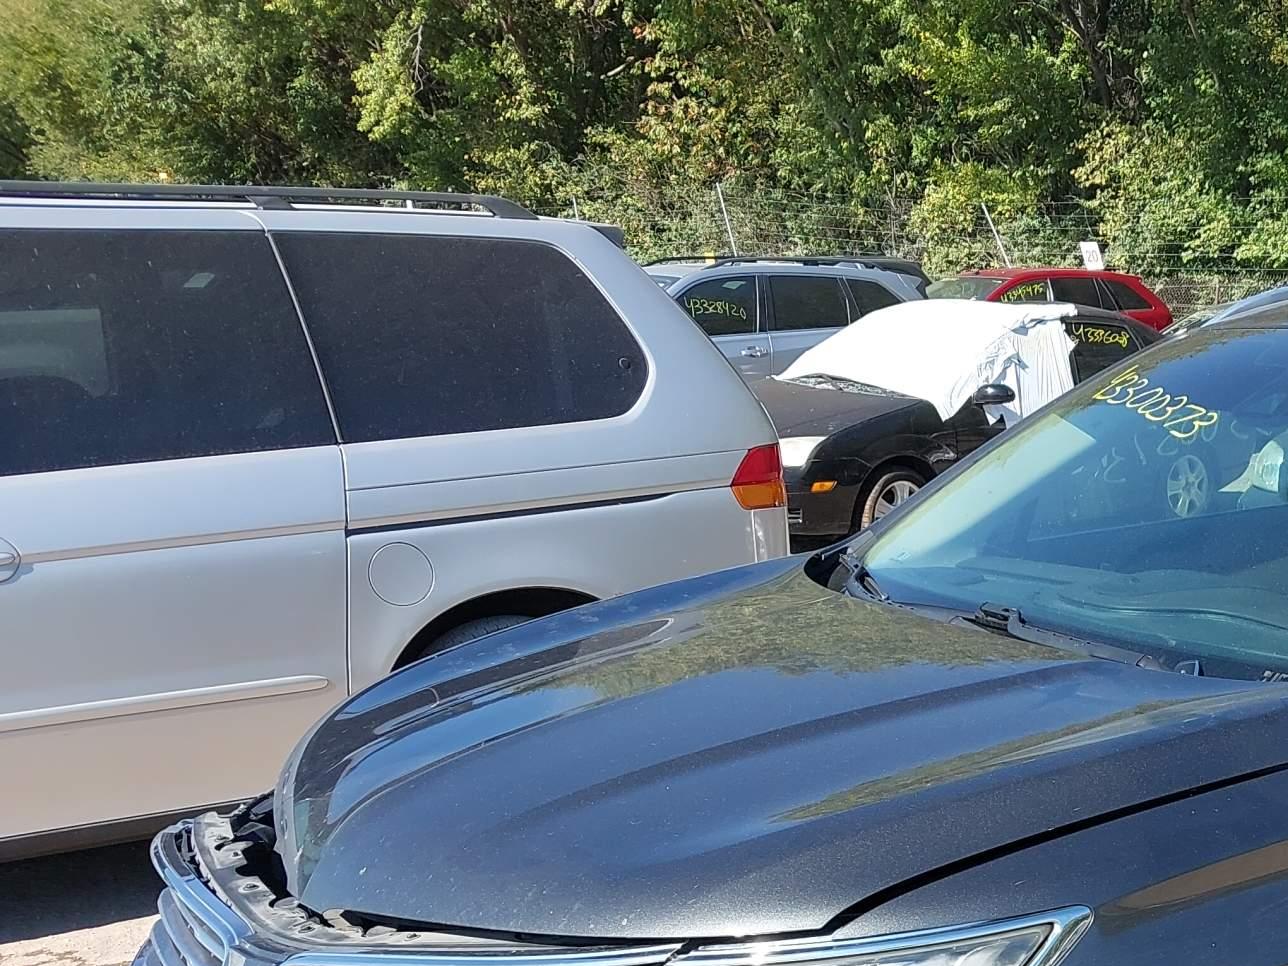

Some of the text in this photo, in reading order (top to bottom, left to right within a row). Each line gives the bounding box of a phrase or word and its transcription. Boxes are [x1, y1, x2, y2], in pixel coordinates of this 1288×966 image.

[1085, 249, 1099, 262] 20
[683, 295, 747, 320] 43328420
[1092, 364, 1218, 438] 43300373
